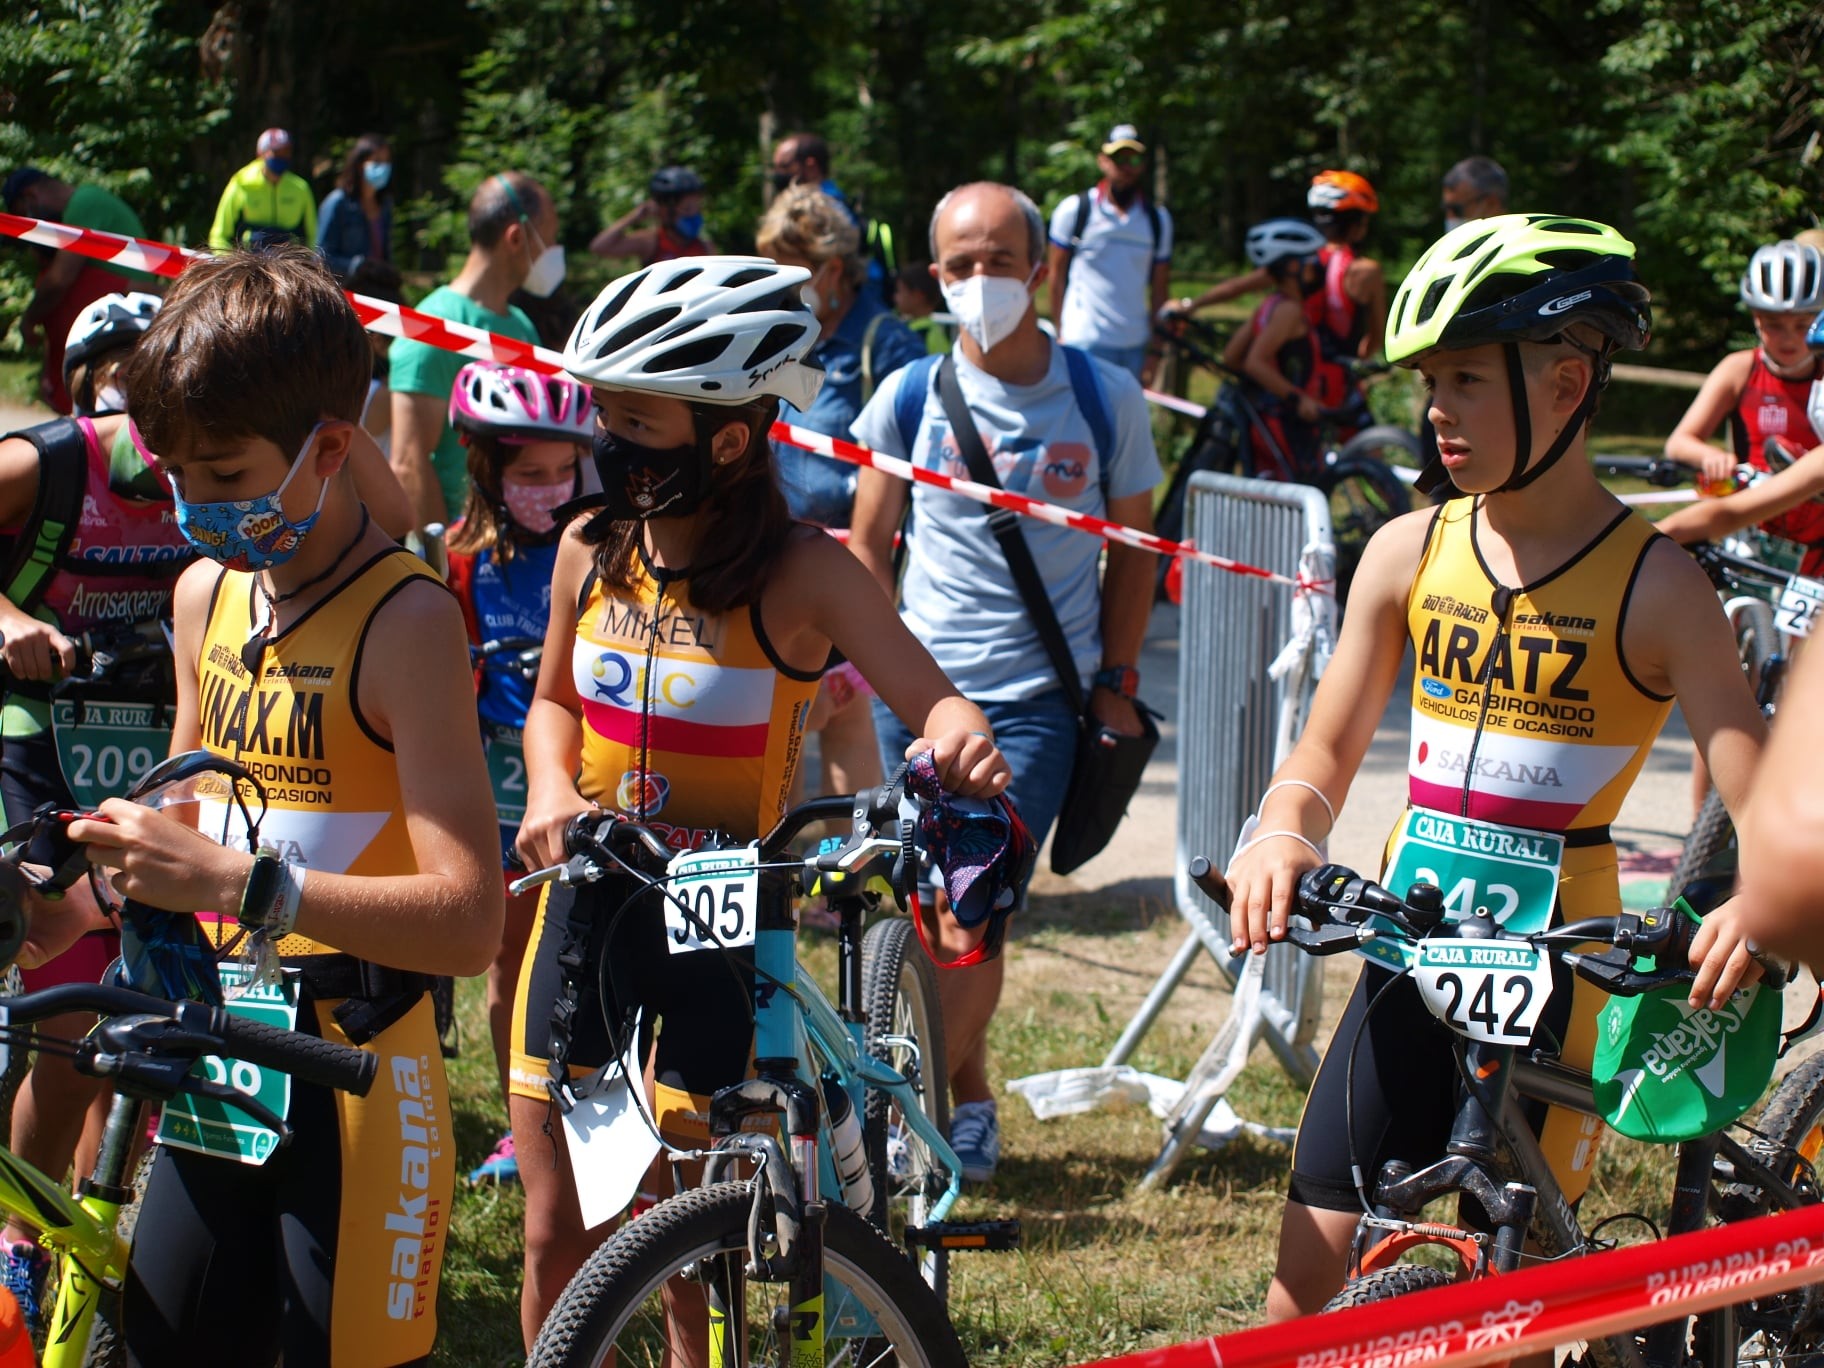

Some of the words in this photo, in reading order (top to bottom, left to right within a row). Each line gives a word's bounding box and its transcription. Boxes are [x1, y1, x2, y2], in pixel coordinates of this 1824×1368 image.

[603, 603, 714, 649] MIKEL
[1453, 601, 1490, 625] RACER
[1513, 611, 1597, 631] sakana
[265, 661, 335, 680] sakana
[1420, 618, 1590, 702] ARATZ
[61, 706, 105, 724] CJA
[108, 708, 170, 727] RUR
[1418, 696, 1478, 723] VEHICULOS
[1485, 714, 1508, 729] DE
[1513, 719, 1594, 738] OCASION
[1422, 679, 1445, 697] Ford
[1454, 688, 1596, 723] GABIRONDO
[71, 744, 154, 788] 209
[501, 756, 525, 790] 2
[1438, 750, 1563, 787] SAKANA
[257, 786, 332, 803] CASION
[1415, 816, 1456, 845] CAJA
[1461, 827, 1549, 861] RURAL
[1426, 947, 1467, 964] CAJA
[1470, 949, 1532, 967] RURAL
[1435, 971, 1533, 1037] 242
[420, 1055, 441, 1159] taldea
[385, 1055, 430, 1321] sakana
